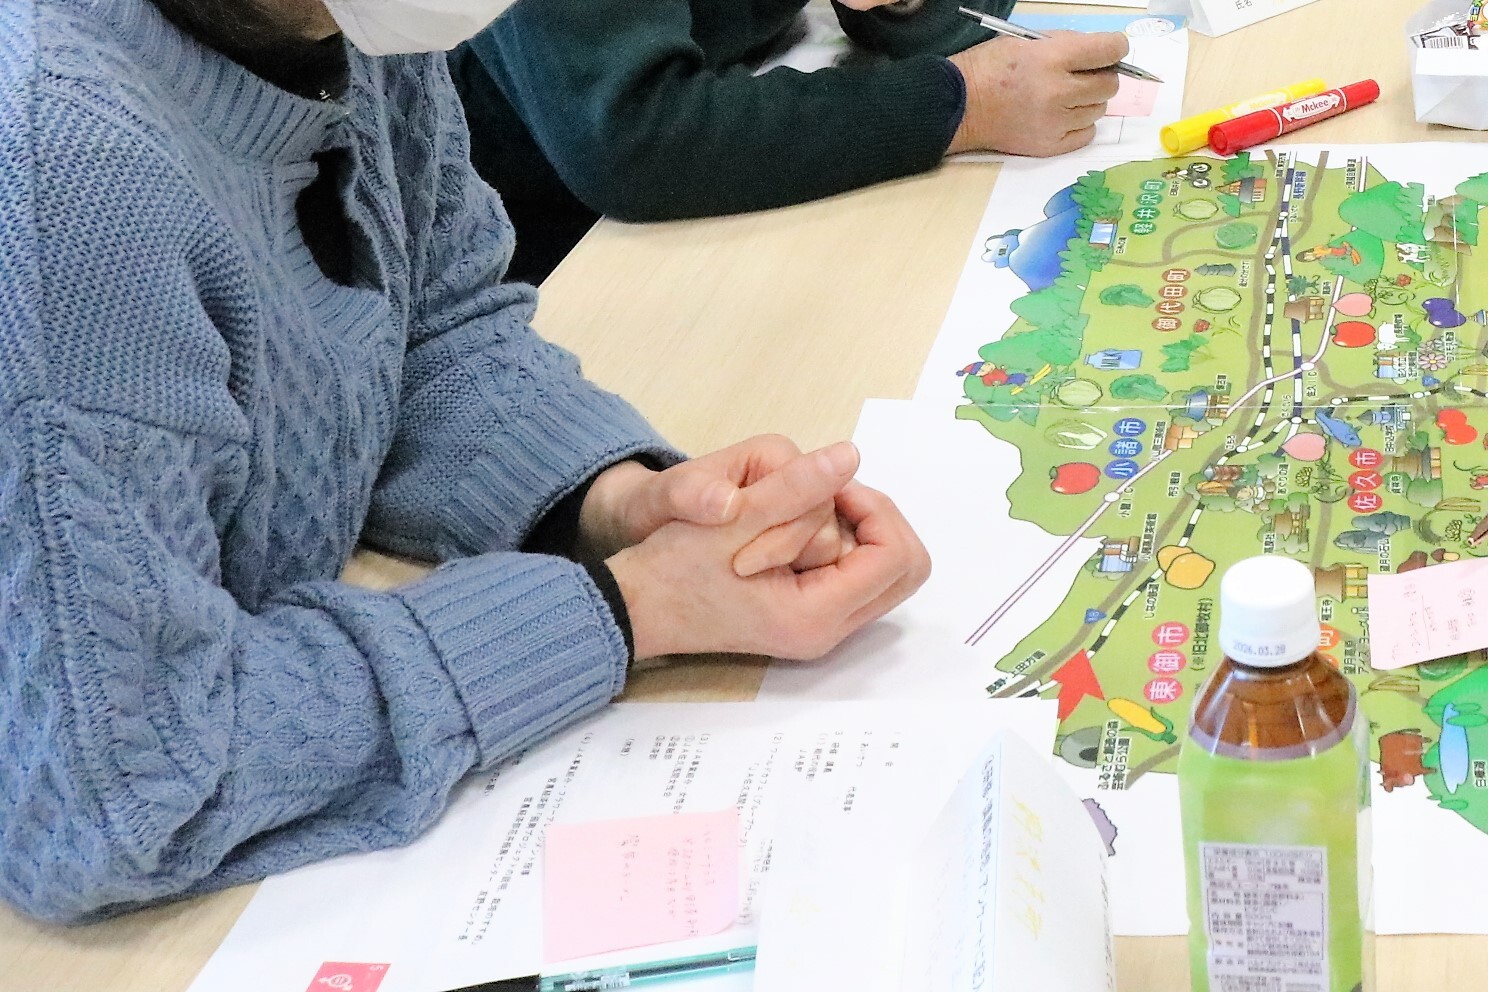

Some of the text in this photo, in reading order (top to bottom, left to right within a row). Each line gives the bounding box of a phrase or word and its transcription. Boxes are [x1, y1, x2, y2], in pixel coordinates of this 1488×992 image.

[1131, 179, 1163, 235] 軽井沢町
[1291, 170, 1307, 200] 長野新幹線
[1155, 269, 1188, 331] 御代田町
[1108, 418, 1141, 477] 小諸市
[1350, 450, 1378, 511] 佐久市
[1378, 537, 1392, 573] 望月の石仏
[1149, 624, 1185, 700] 東御市
[1344, 640, 1356, 675] 望月高原
